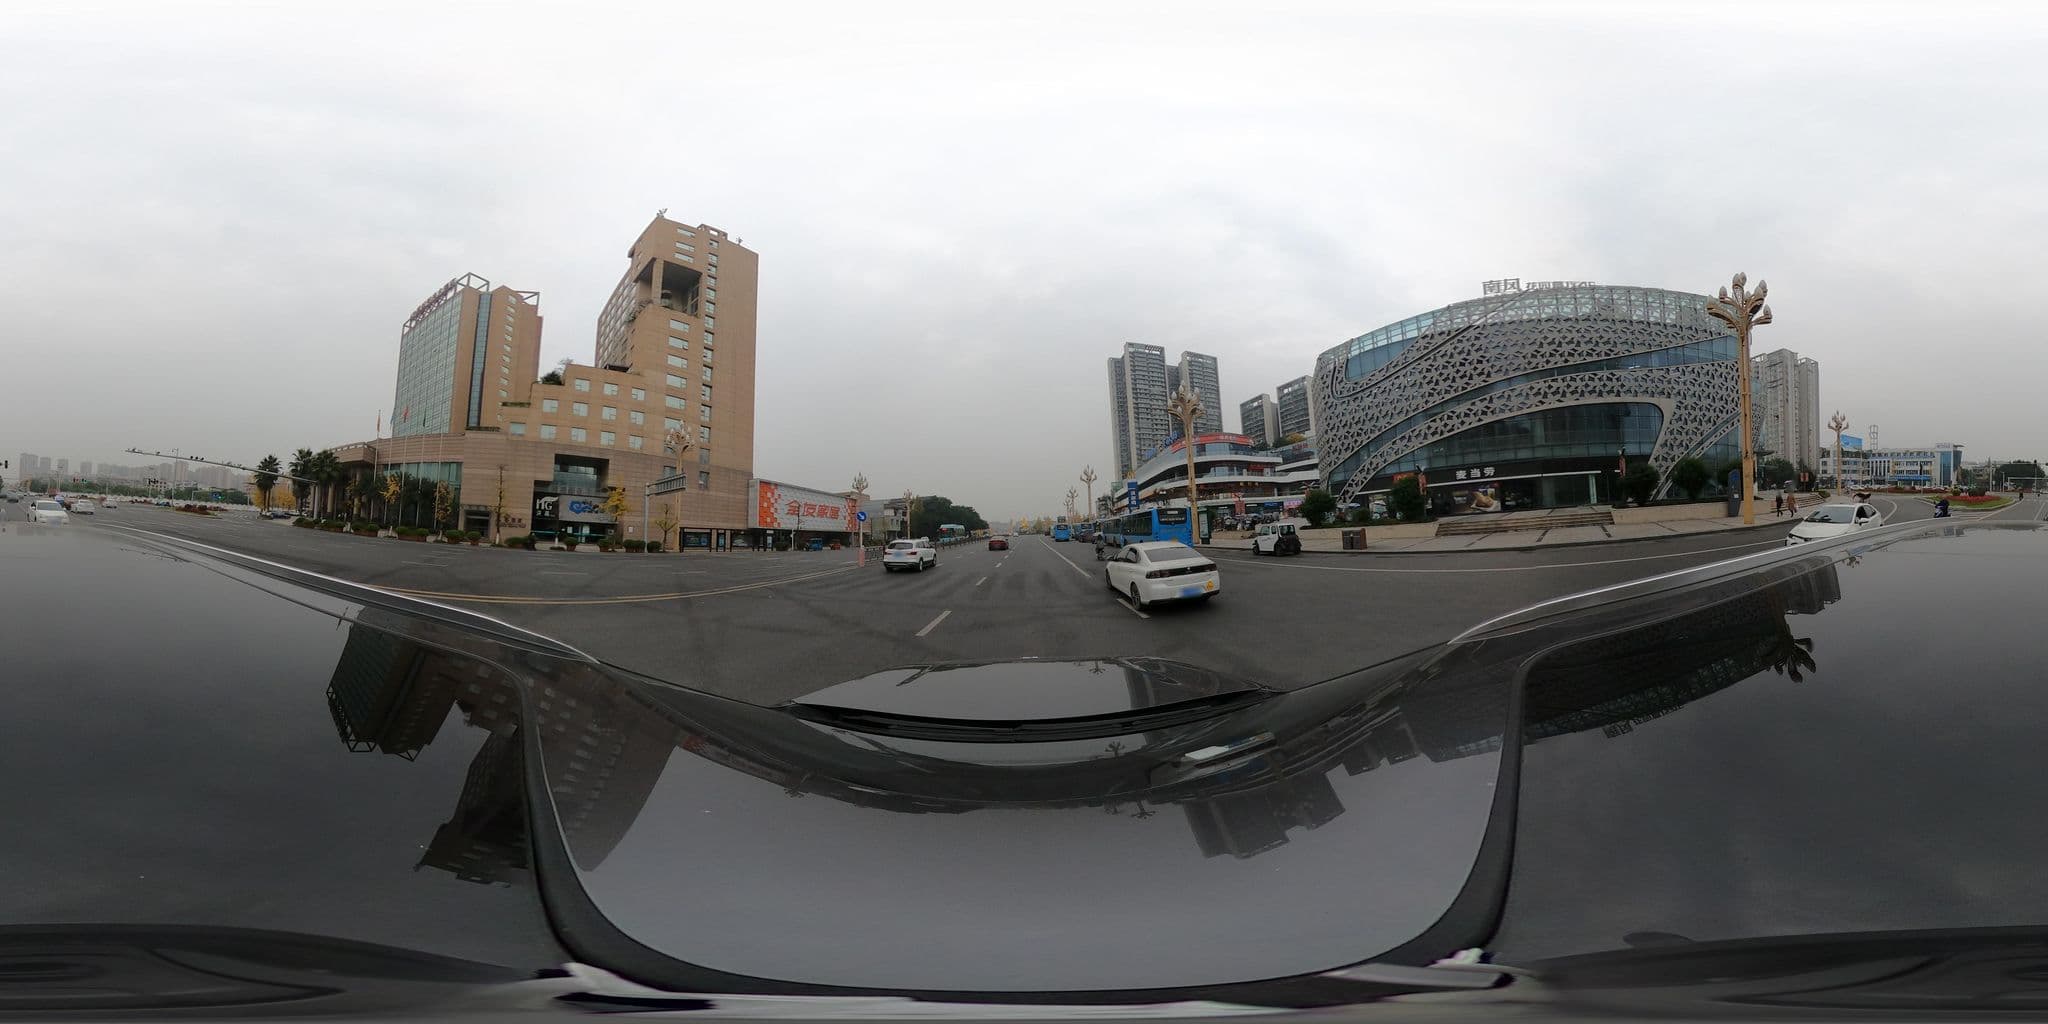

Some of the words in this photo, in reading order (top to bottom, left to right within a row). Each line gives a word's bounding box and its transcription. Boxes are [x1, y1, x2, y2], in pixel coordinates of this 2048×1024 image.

[1482, 278, 1520, 295] 南风
[1456, 467, 1495, 480] 麦当劳
[786, 499, 840, 519] 全友家居
